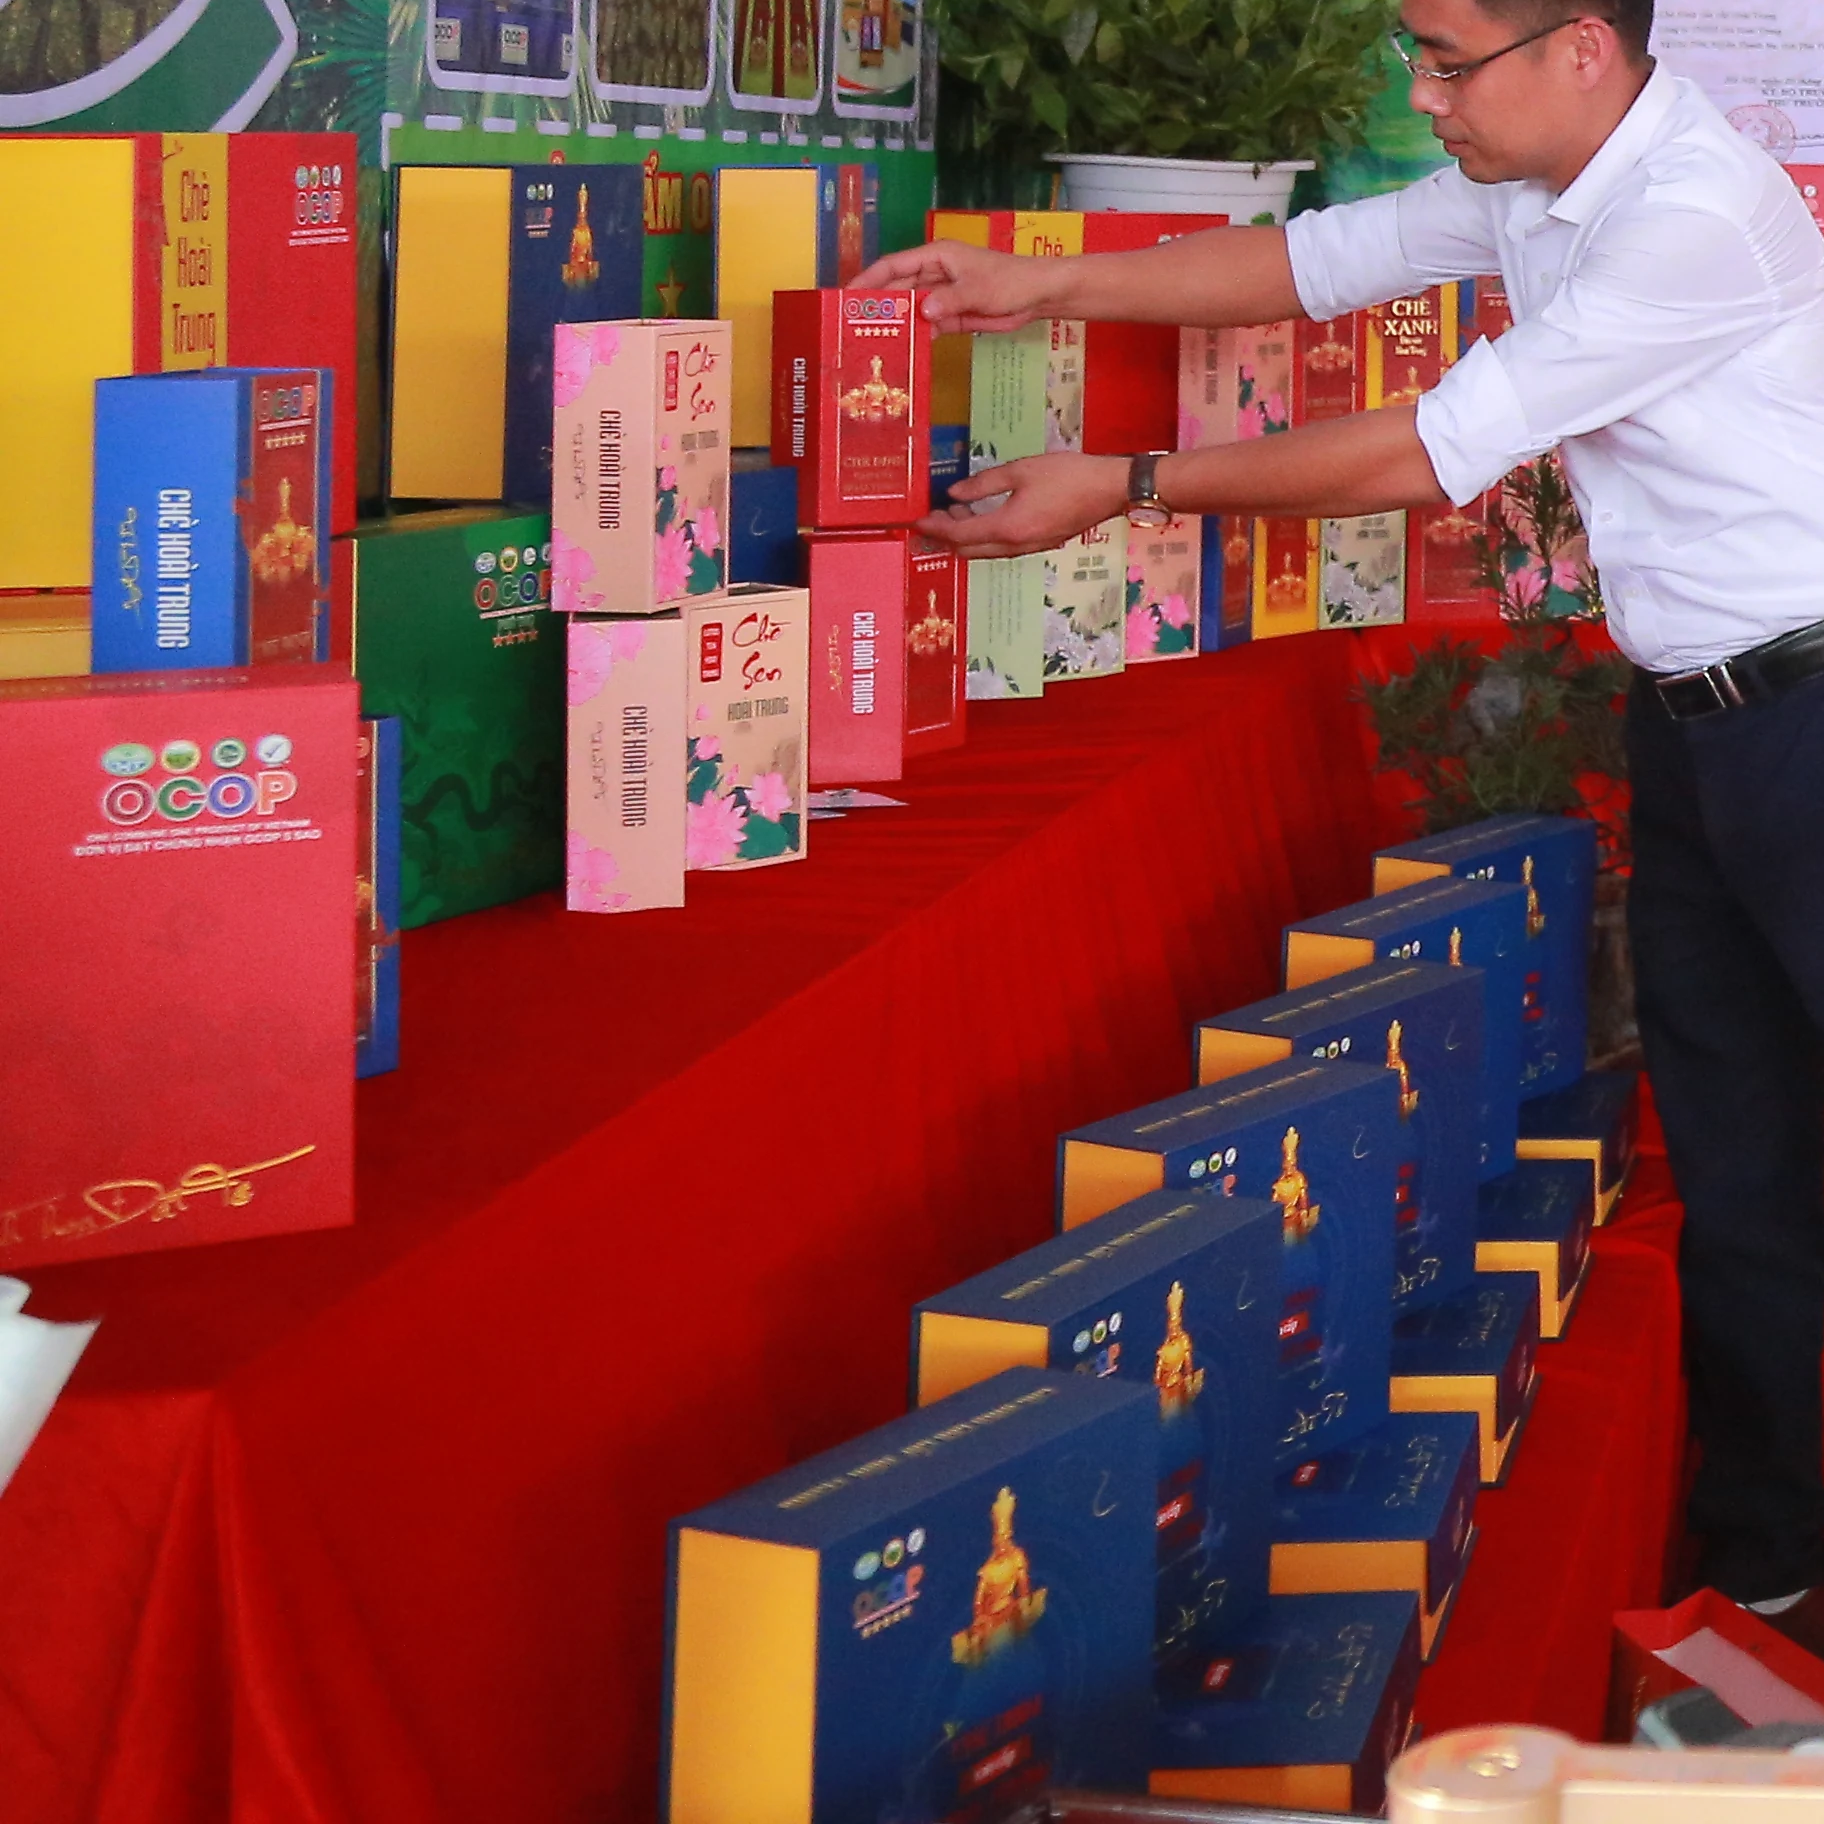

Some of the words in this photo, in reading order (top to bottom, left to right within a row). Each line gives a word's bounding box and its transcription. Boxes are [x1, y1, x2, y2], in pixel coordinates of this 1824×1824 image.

[179, 168, 211, 224] Chè
[294, 189, 343, 225] OCOP
[177, 241, 213, 289] Hoài
[845, 298, 909, 318] OCOP
[1384, 319, 1439, 336] XANH
[1391, 298, 1431, 319] CHÈ
[172, 303, 217, 369] Trung
[158, 488, 200, 529] CHÈ
[157, 533, 199, 579] HOÀI
[156, 584, 191, 649] TRUNG
[852, 612, 879, 640] CHÈ
[852, 643, 879, 672] HOÀI
[852, 674, 874, 715] TRUNG
[622, 706, 654, 736] CHÈ
[622, 740, 654, 775] HOÀI
[103, 770, 298, 826] OCOP
[622, 777, 648, 828] TRUNG
